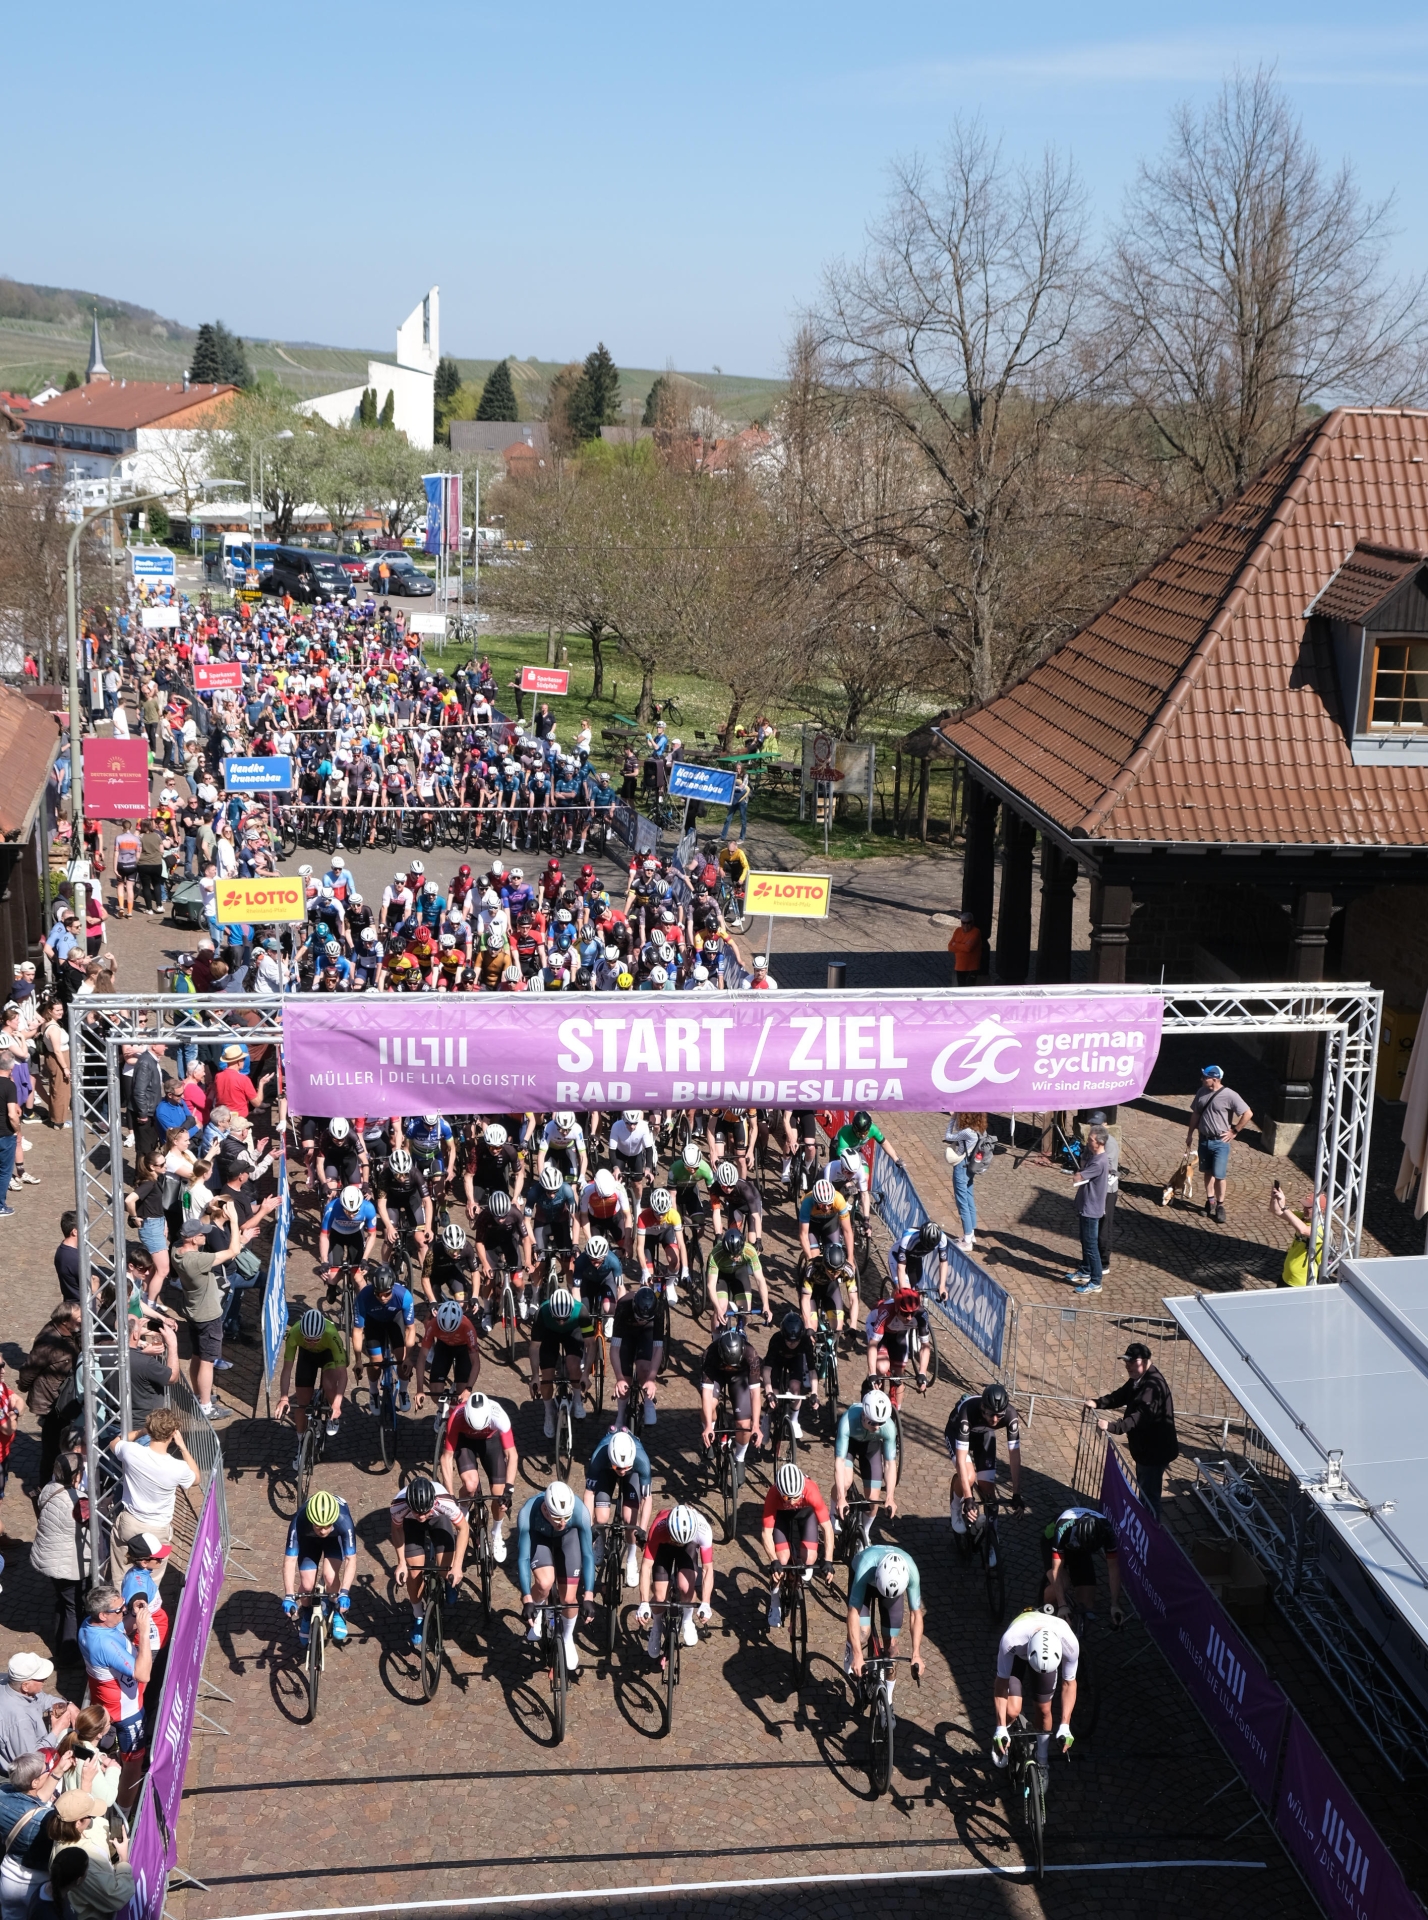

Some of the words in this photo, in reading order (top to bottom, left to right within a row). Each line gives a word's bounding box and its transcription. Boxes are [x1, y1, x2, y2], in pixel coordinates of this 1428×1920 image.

[537, 675, 563, 683] Sparkasse
[229, 763, 265, 773] Handke
[676, 767, 710, 782] Handke
[230, 773, 282, 783] Brunnenbau
[674, 777, 724, 794] Brunnenbau
[245, 890, 299, 905] LOTTO
[774, 884, 824, 899] LOTTO
[557, 1017, 733, 1073] START
[788, 1015, 908, 1072] ZIEL
[1034, 1029, 1146, 1057] german
[1032, 1050, 1136, 1079] cycling
[309, 1070, 374, 1087] MÜLLER
[388, 1071, 415, 1085] DIE
[421, 1072, 456, 1086] LILA
[462, 1073, 537, 1088] LOGISTIK
[1032, 1080, 1052, 1092] Wir
[1054, 1079, 1081, 1091] sind
[556, 1081, 632, 1103] RAD
[671, 1078, 904, 1104] BUNDESLIGA
[1179, 1627, 1203, 1672] MÜLLER
[1207, 1675, 1219, 1694] DIE
[1219, 1688, 1234, 1718] LILA
[1234, 1710, 1269, 1767] LOGISTIK
[1319, 1848, 1335, 1879] DIE
[1336, 1873, 1354, 1911] LILA
